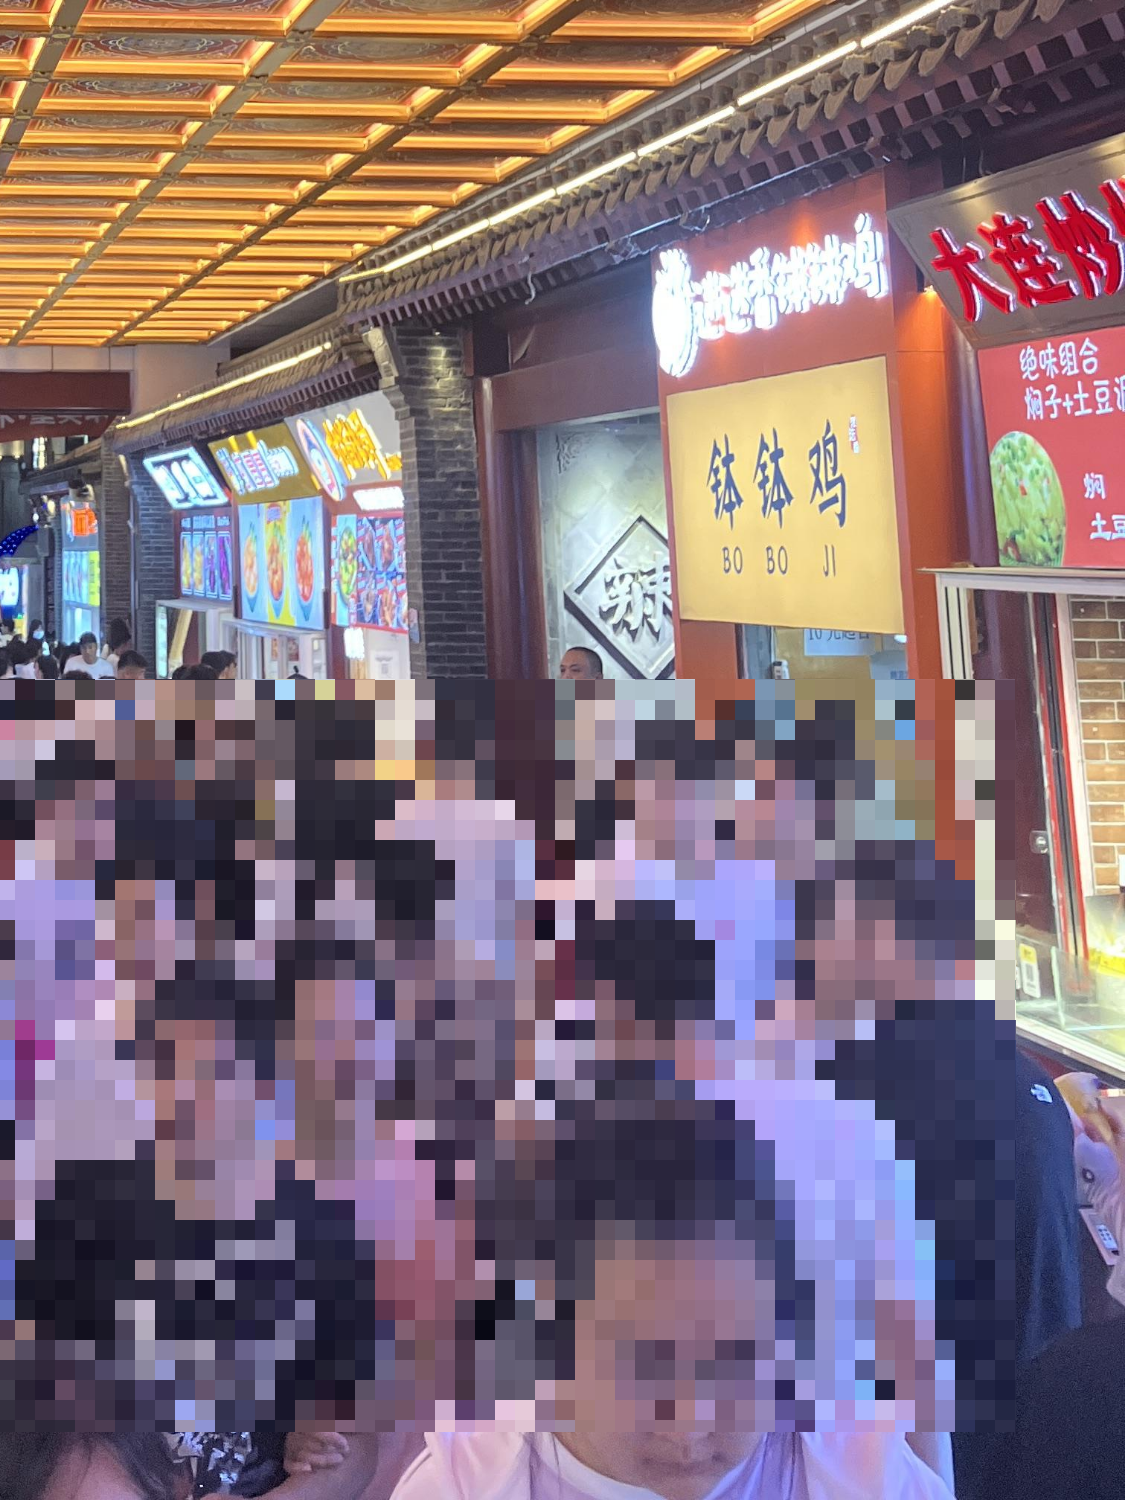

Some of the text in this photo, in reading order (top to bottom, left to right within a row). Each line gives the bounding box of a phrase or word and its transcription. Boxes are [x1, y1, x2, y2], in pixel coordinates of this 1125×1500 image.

[1018, 337, 1099, 382] 绝味组合
[706, 418, 847, 531] 钵钵鸡
[598, 551, 672, 633] 辣
[723, 545, 837, 579] BO BO JI
